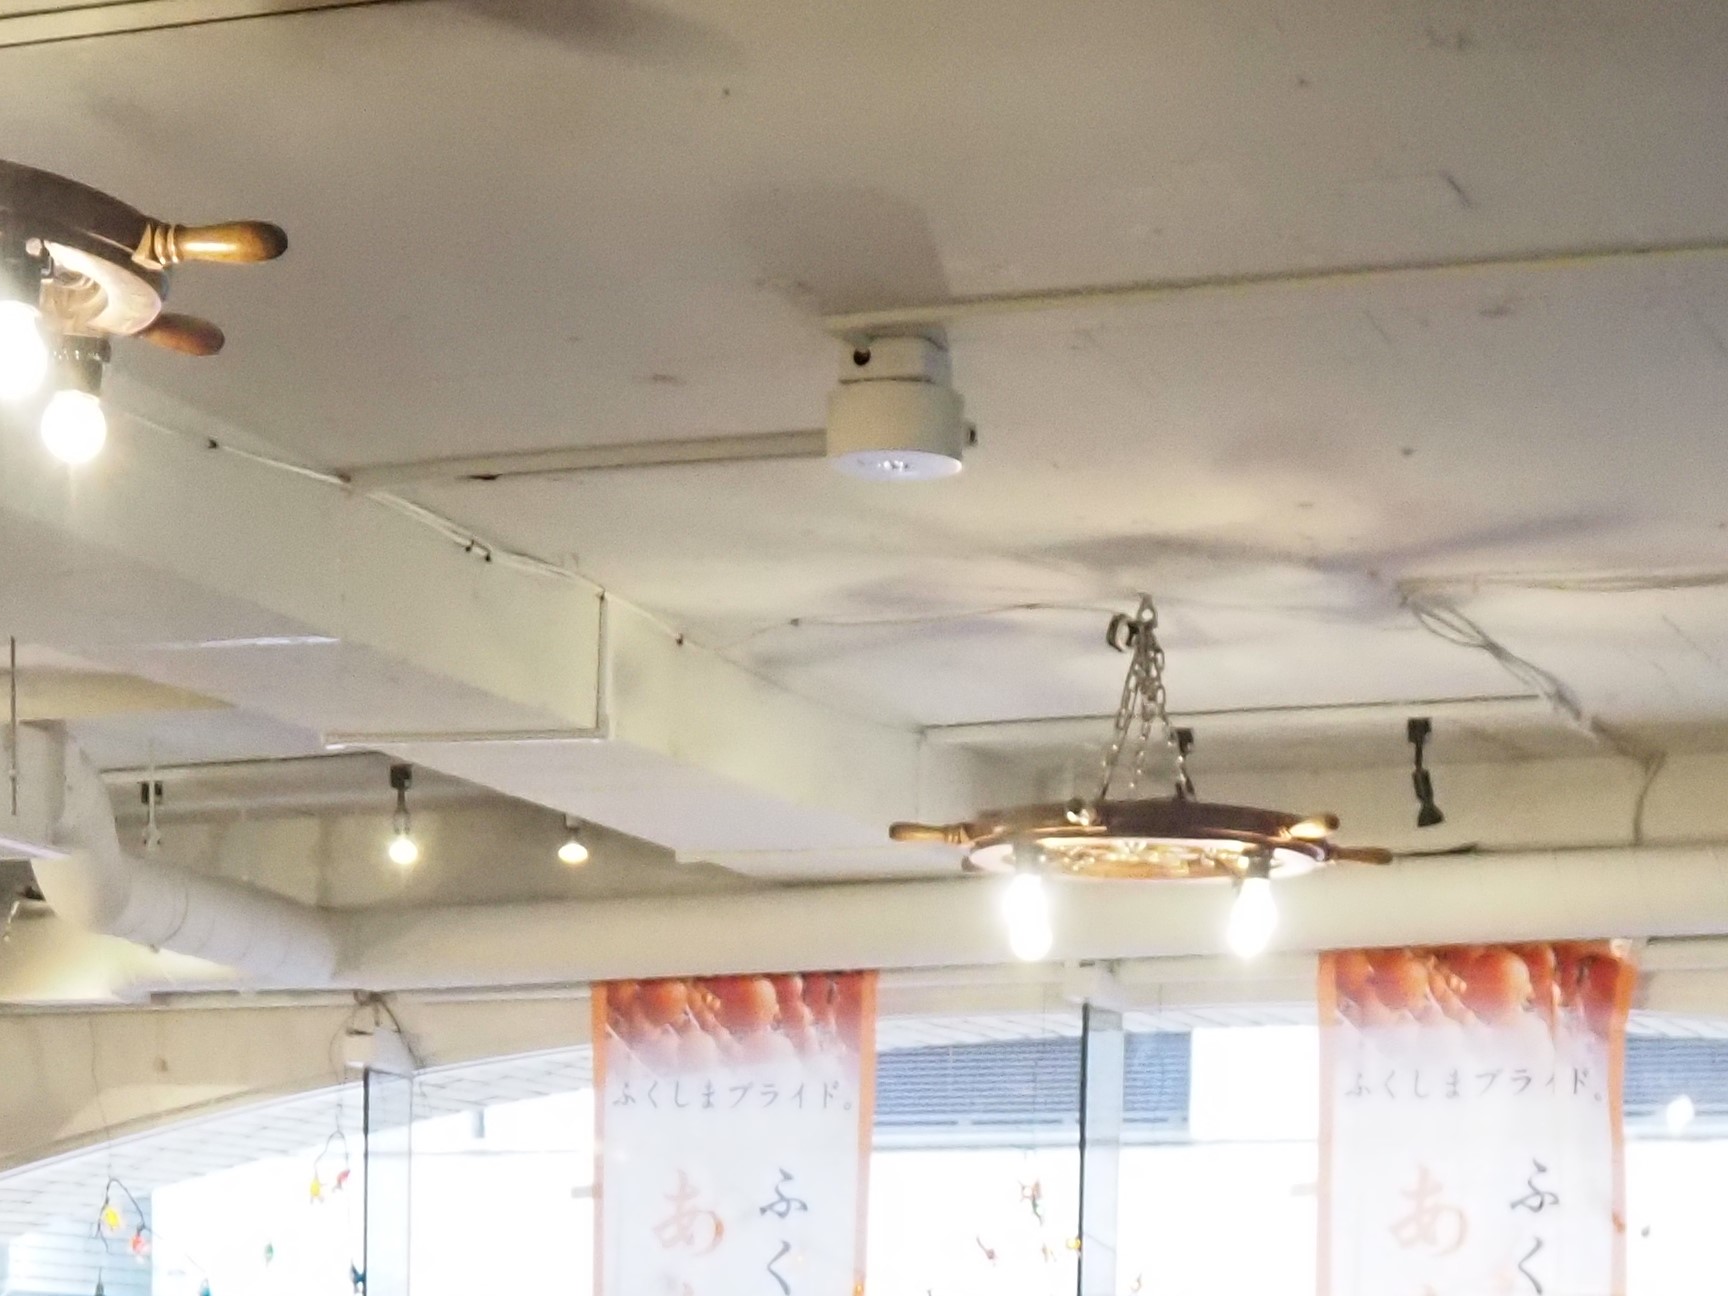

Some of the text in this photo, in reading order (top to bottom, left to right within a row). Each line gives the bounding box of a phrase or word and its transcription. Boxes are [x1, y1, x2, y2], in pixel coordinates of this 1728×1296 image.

[612, 1078, 853, 1112] ふくしまプライド。
